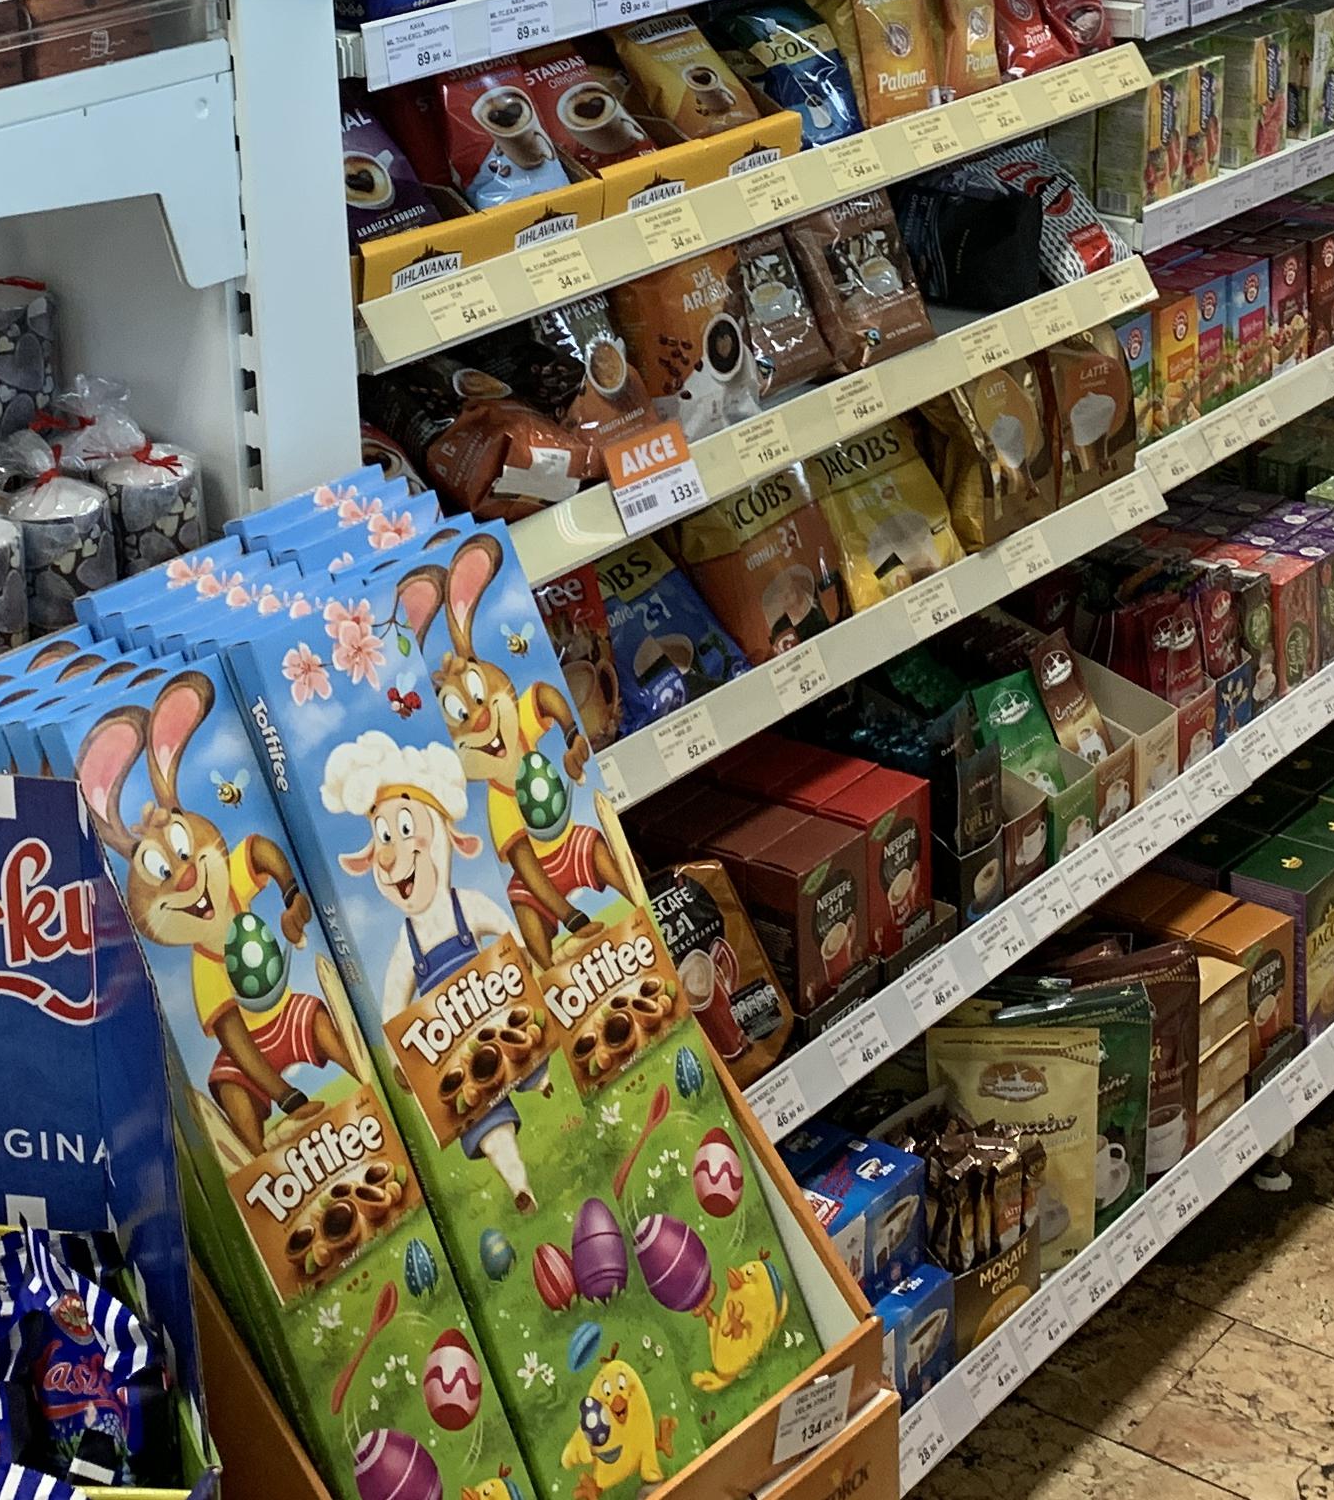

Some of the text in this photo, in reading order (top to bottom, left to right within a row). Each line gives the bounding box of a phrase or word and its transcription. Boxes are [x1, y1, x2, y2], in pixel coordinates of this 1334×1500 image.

[878, 68, 927, 94] Paloma
[517, 218, 576, 249] JIHLAVANKA
[395, 256, 460, 290] JIHLAVANKA
[981, 380, 1008, 400] LATTE
[619, 433, 678, 477] AKCE
[819, 427, 902, 484] JACOBS
[248, 694, 292, 795] Toffifee
[544, 934, 656, 1030] Toffifee
[401, 963, 525, 1066] Toffifee
[246, 1115, 384, 1225] Toffifee
[979, 1238, 1028, 1287] MOKATE
[992, 1266, 1020, 1296] GOLD
